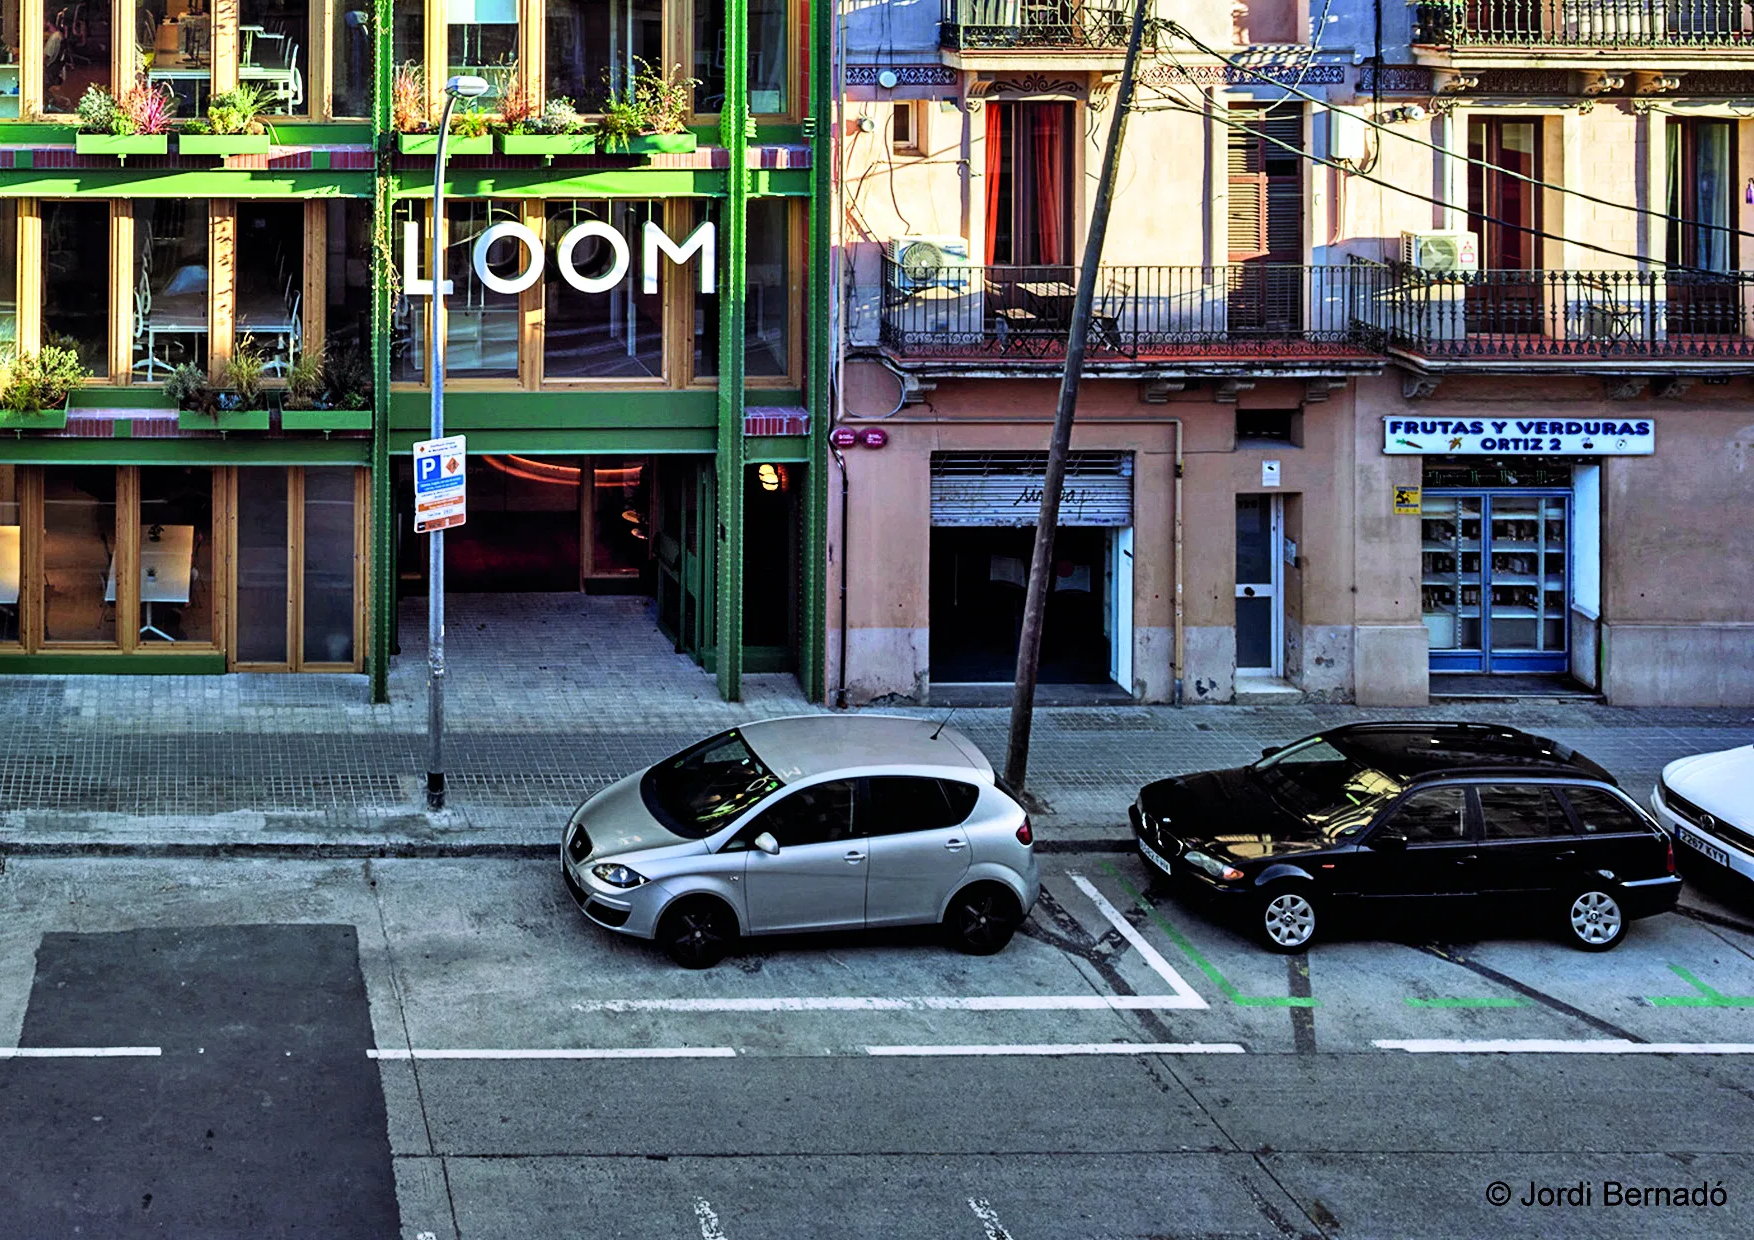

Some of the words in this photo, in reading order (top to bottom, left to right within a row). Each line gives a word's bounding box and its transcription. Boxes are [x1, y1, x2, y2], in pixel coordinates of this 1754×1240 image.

[403, 220, 715, 295] LOOM
[1389, 421, 1484, 435] FRUTAS
[1491, 421, 1508, 434] Y
[1516, 421, 1650, 436] VERDURAS
[1480, 438, 1544, 451] ORTIZ
[1549, 438, 1562, 451] 2
[421, 458, 436, 480] P
